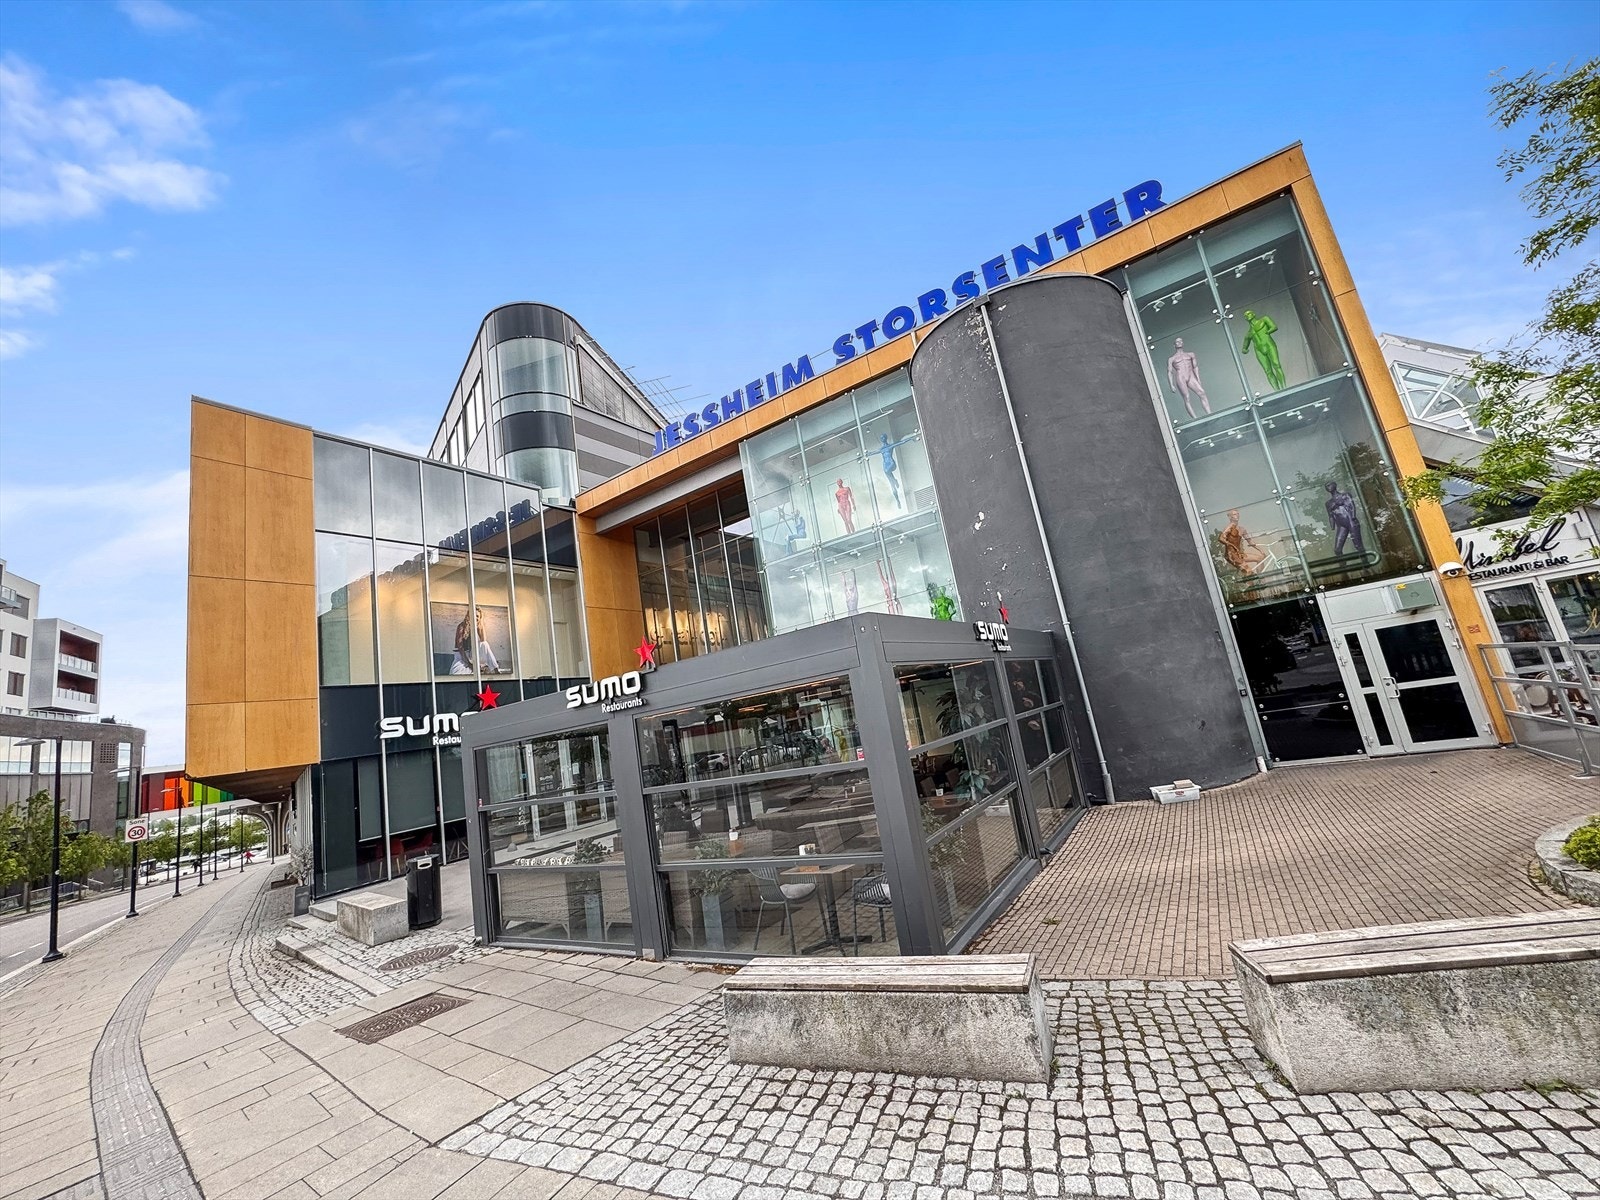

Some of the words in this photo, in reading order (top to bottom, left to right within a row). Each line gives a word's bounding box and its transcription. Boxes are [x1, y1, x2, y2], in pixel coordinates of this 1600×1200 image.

[652, 354, 815, 456] JESSHEIM
[832, 179, 1167, 366] STORSENTER
[1469, 562, 1531, 580] ESTAURANT
[1533, 560, 1544, 569] &
[1545, 555, 1570, 568] BAR
[977, 621, 1009, 641] SUMO
[566, 671, 641, 709] SUMO
[601, 697, 643, 713] Restaurants
[380, 711, 479, 739] SUM
[432, 736, 462, 746] Restau
